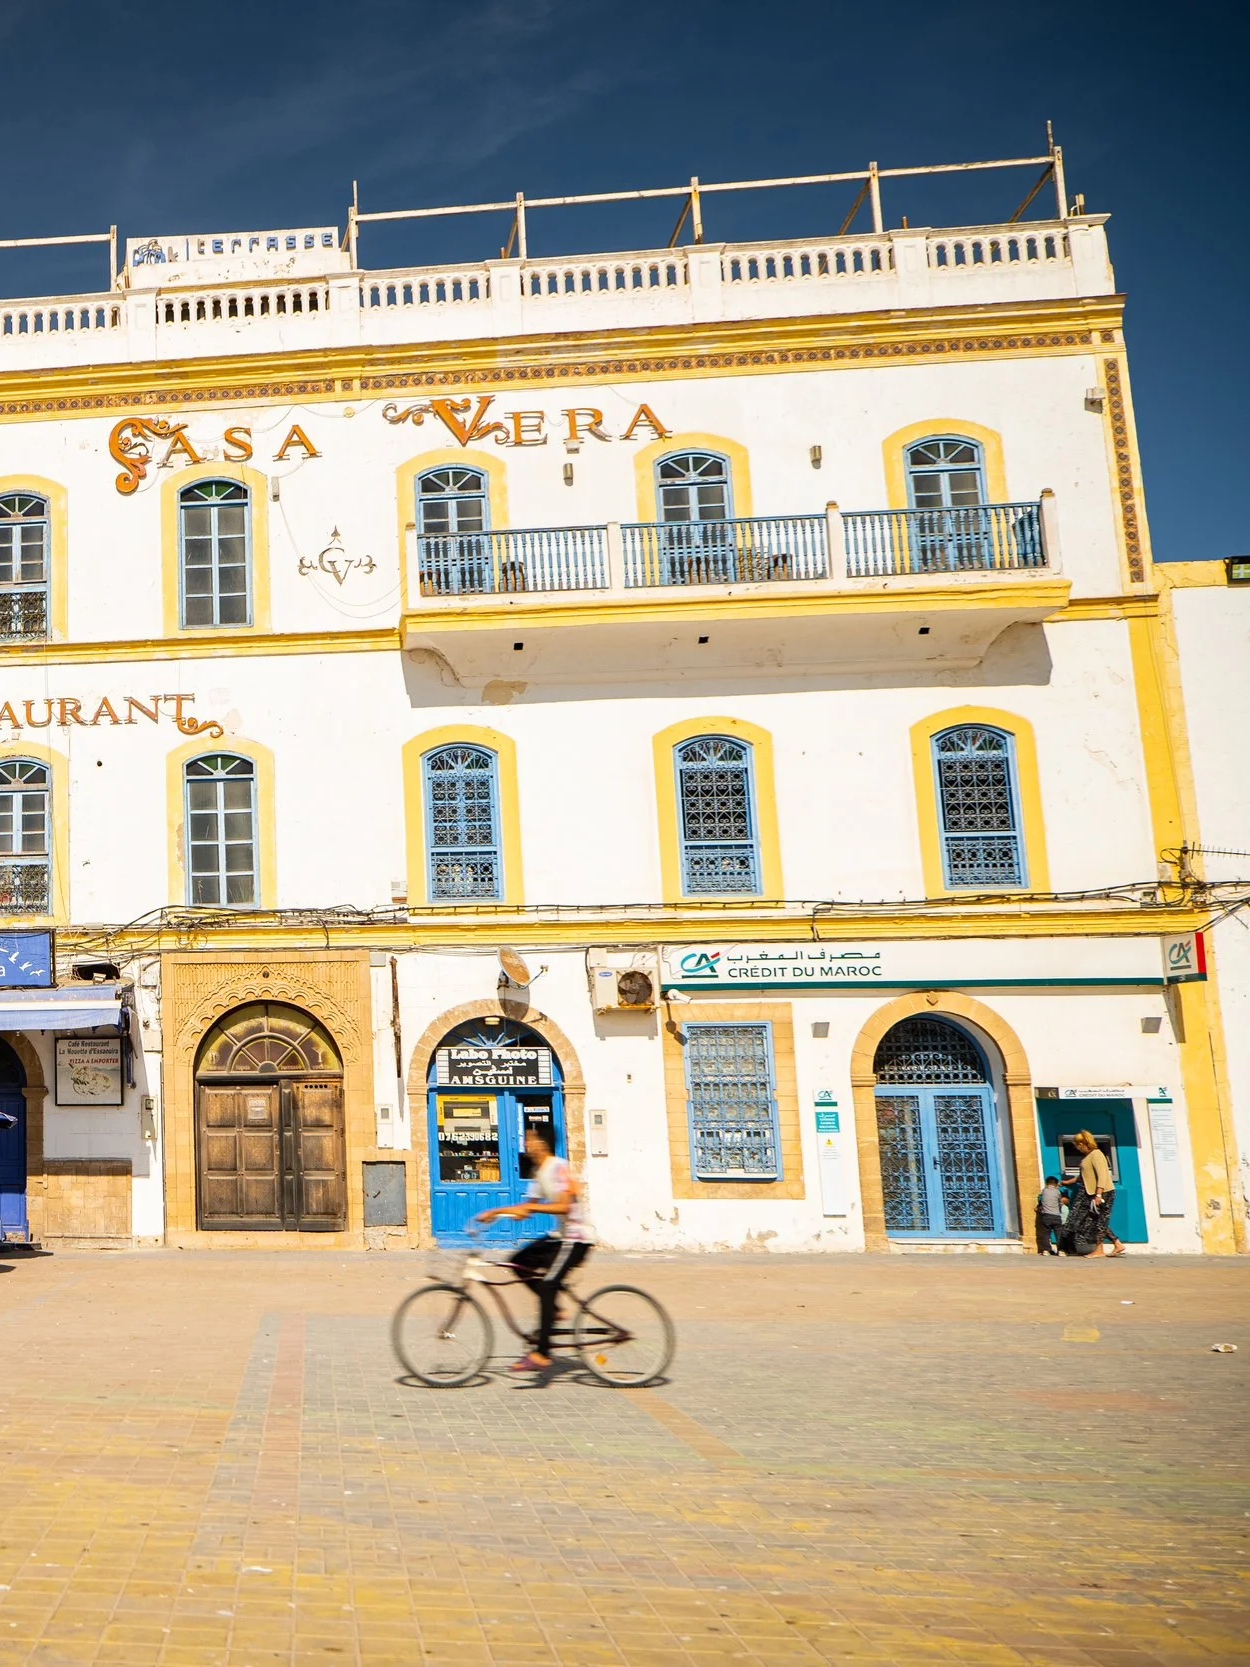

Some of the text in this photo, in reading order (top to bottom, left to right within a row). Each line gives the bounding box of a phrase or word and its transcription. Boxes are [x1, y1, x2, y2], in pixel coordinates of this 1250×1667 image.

[109, 395, 673, 495] CASA VERA
[727, 948, 881, 964] مصرف المغرب
[728, 965, 882, 978] CRÉDIT DU MAROC
[450, 1049, 537, 1060] Labo Photo
[450, 1076, 537, 1085] AMSGUINE
